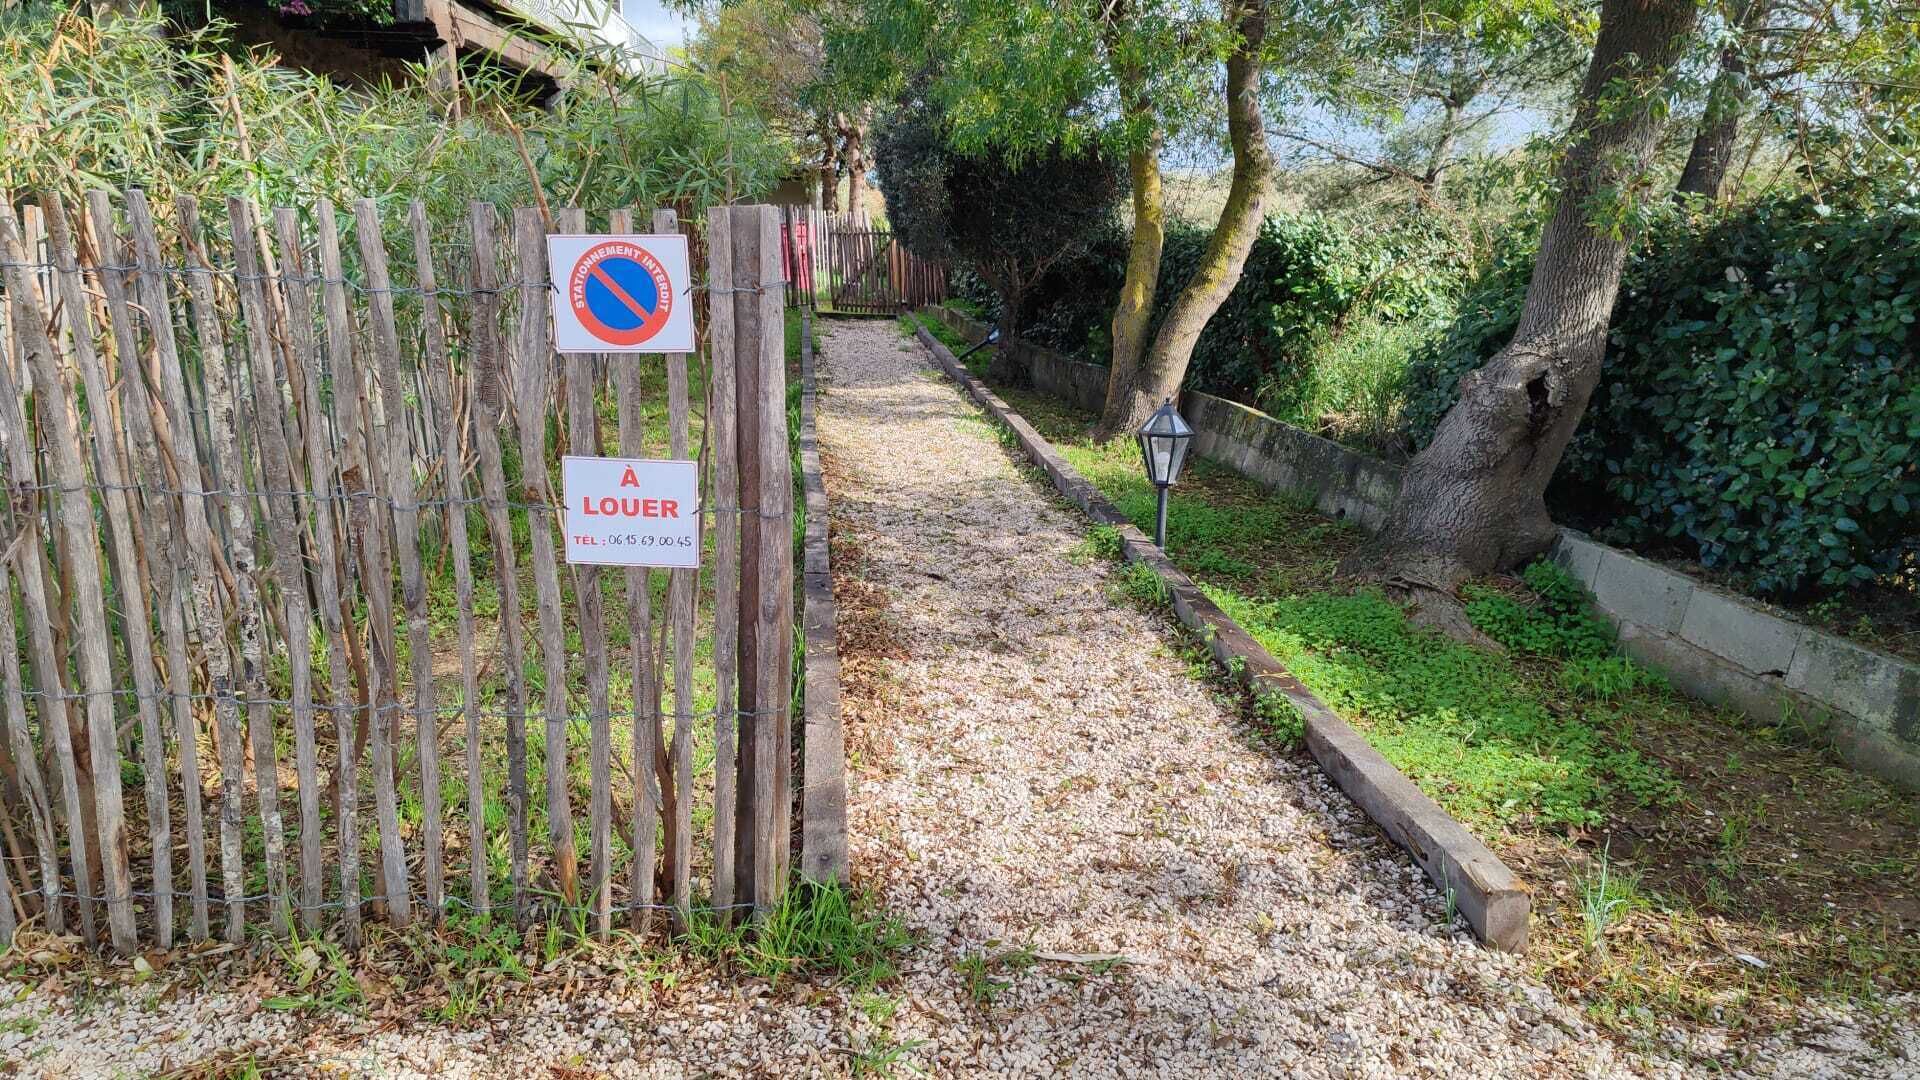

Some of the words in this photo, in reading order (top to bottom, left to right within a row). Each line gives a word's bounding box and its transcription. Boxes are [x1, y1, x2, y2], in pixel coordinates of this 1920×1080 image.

[574, 245, 641, 309] STATIONNEMENT
[642, 255, 669, 312] INTERDIT
[620, 464, 640, 487] À
[584, 497, 679, 518] LOUER
